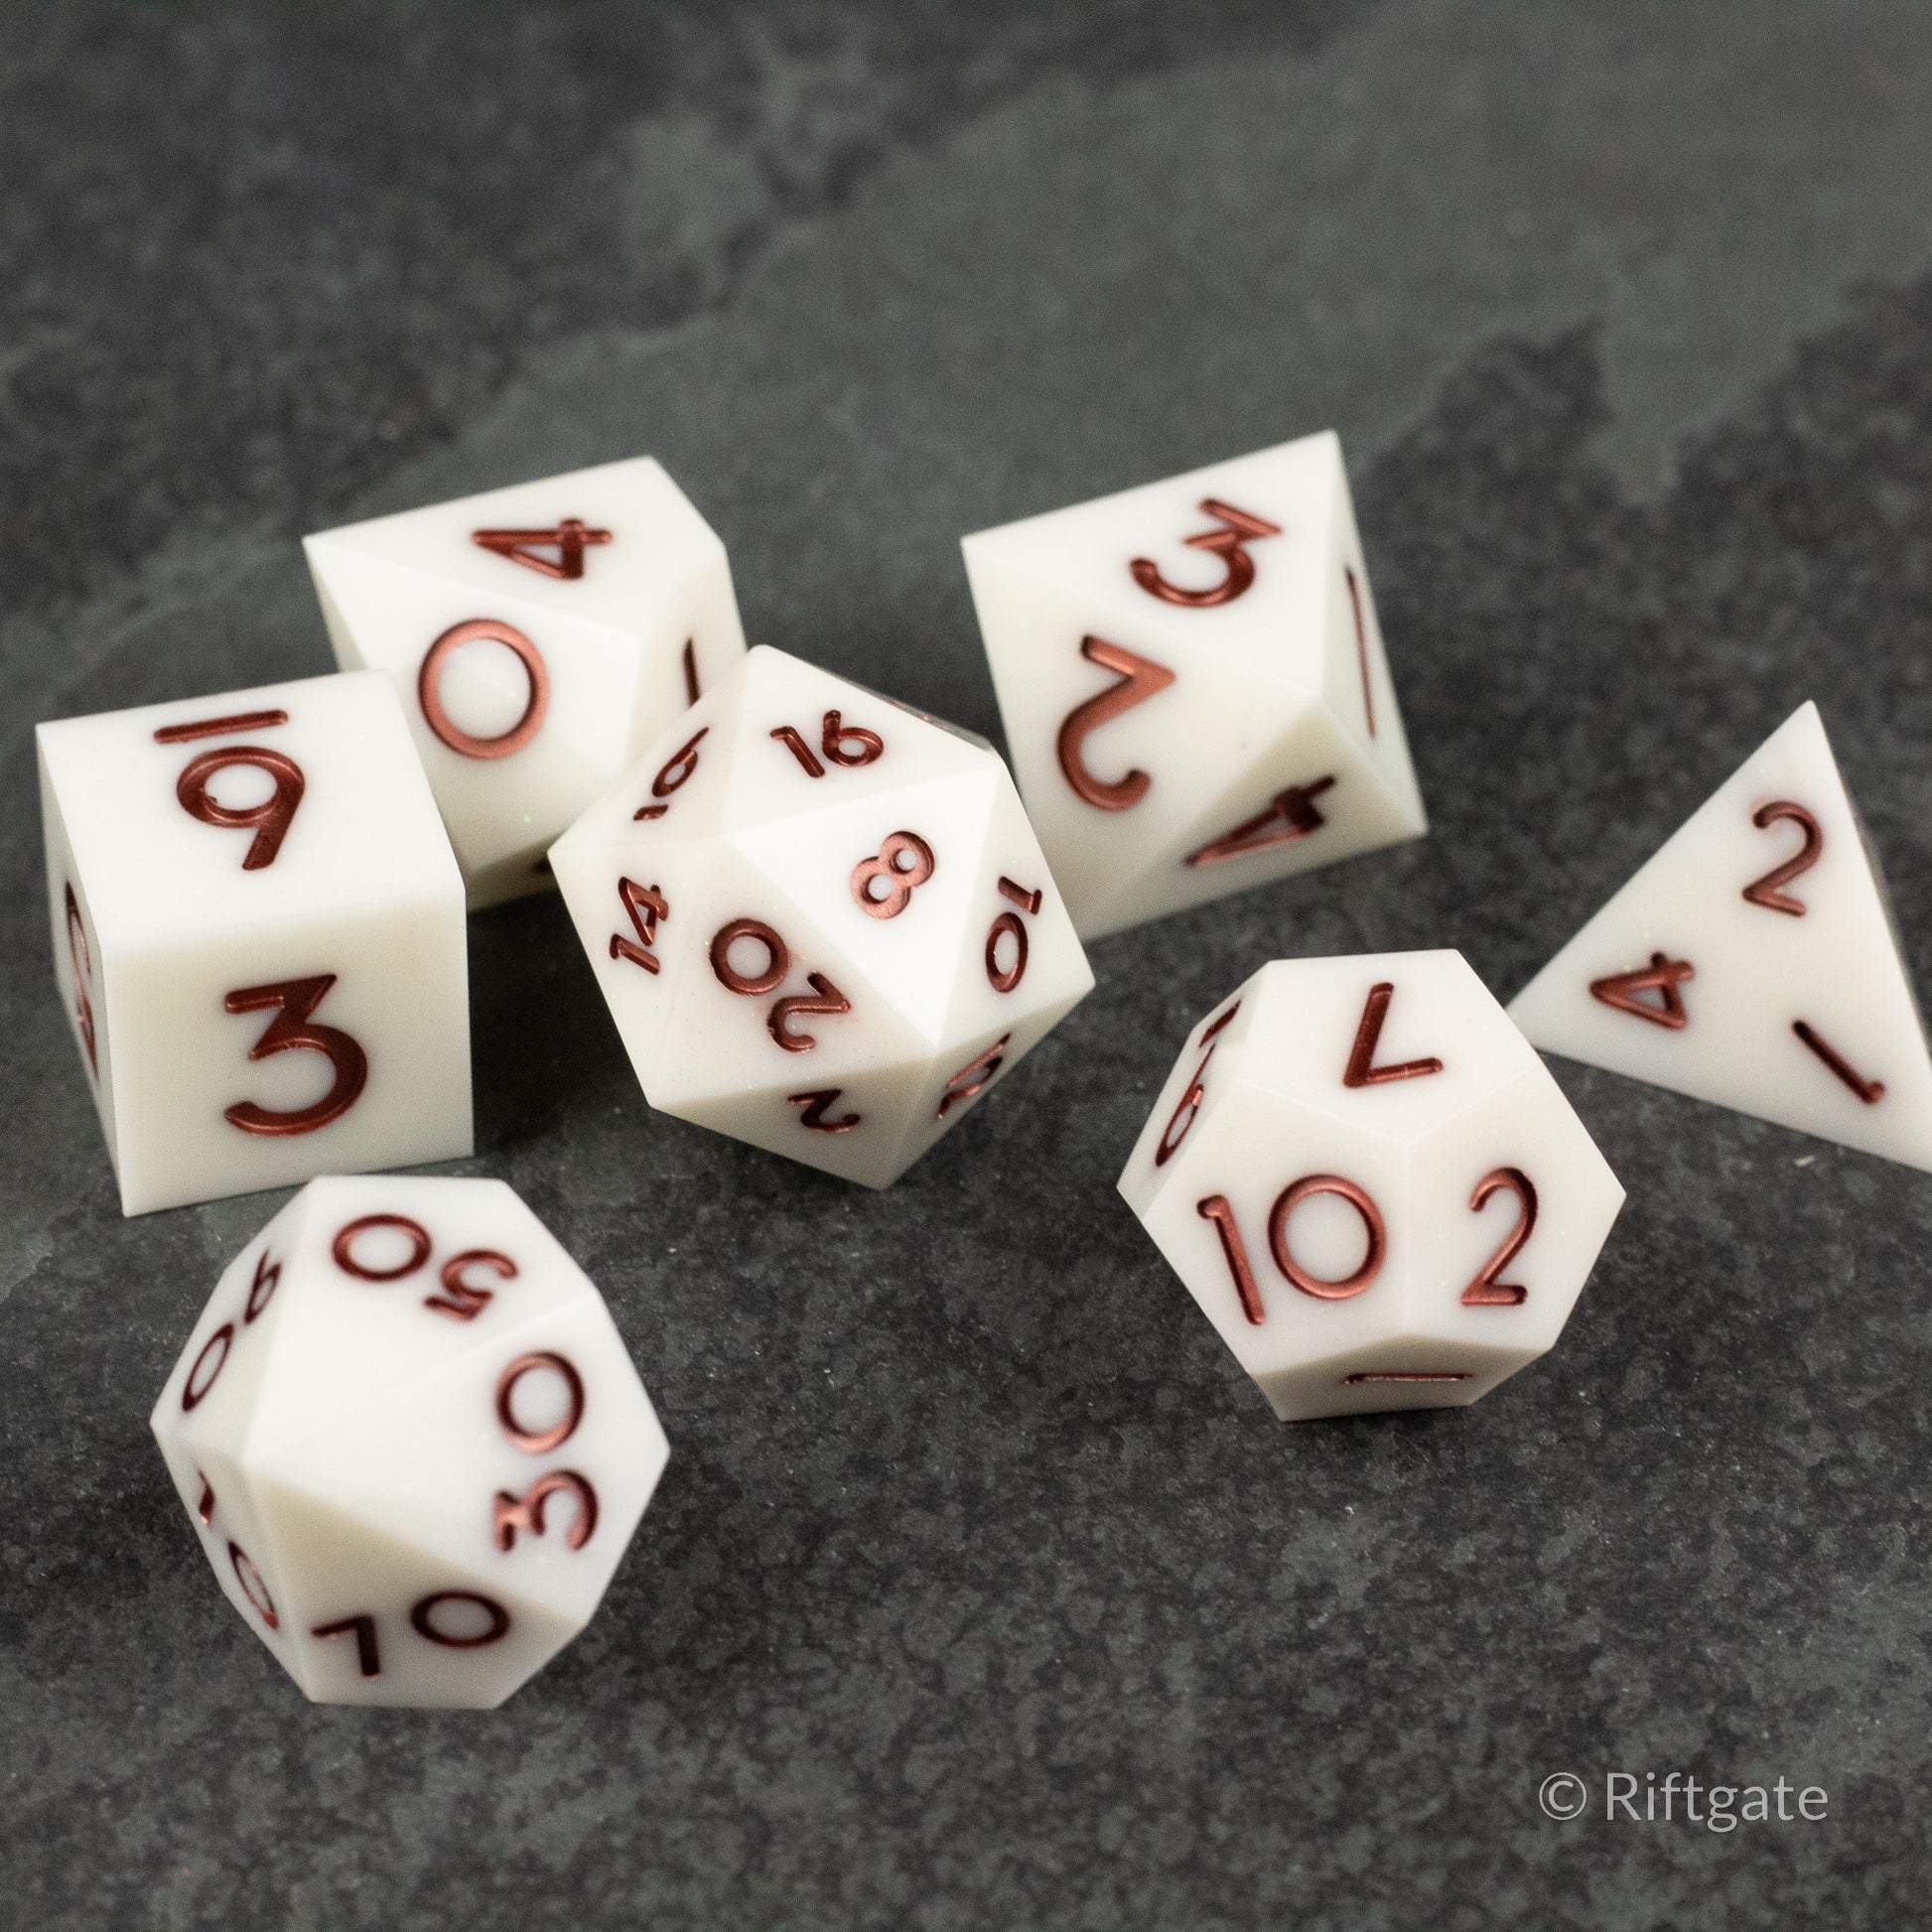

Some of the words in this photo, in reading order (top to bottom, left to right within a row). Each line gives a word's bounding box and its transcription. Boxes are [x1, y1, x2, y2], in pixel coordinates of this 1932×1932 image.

[471, 517, 614, 583] 4
[1129, 497, 1283, 610] 3
[417, 618, 551, 761] 0
[769, 709, 887, 779] 16
[1054, 633, 1177, 814] 2
[850, 829, 937, 921] 8
[1184, 774, 1337, 868] 4
[1740, 798, 1825, 919] 2
[609, 877, 671, 977] 14
[984, 876, 1042, 995] 10
[707, 915, 855, 1055] 20
[1339, 980, 1446, 1091] 7
[1587, 950, 1697, 1033] 4
[223, 973, 369, 1139] 3
[786, 1088, 862, 1134] 2
[1791, 1020, 1887, 1107] 1
[330, 1212, 521, 1324] 50
[1193, 1171, 1390, 1328] 10
[1458, 1164, 1540, 1309] 2
[491, 1349, 601, 1556] 30
[310, 1588, 511, 1680] 70
